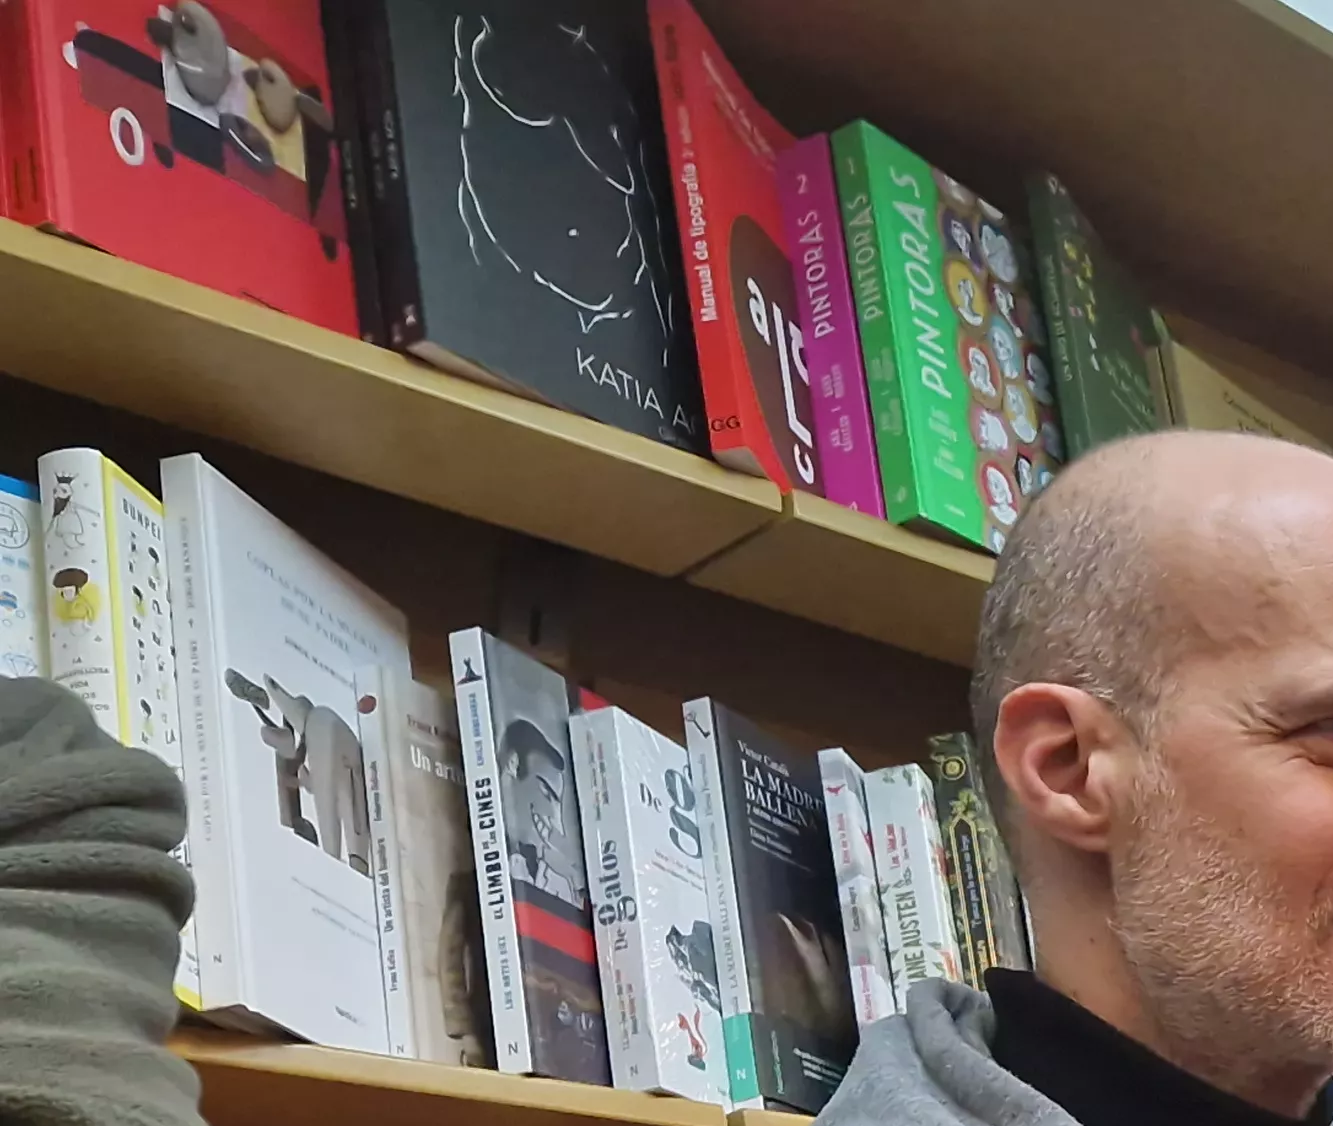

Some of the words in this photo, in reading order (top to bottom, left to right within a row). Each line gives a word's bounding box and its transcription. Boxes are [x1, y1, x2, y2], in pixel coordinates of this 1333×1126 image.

[692, 240, 709, 261] de
[846, 193, 885, 321] PINTORAS
[797, 210, 835, 338] PINTORAS
[890, 165, 953, 399] PINTORAS
[694, 265, 719, 322] Manual
[576, 347, 664, 419] KATIA
[711, 414, 741, 433] GG
[410, 744, 431, 772] Un
[741, 759, 764, 787] LA
[474, 776, 497, 830] CINES
[640, 782, 663, 813] De
[377, 872, 390, 886] del
[483, 850, 506, 906] LIMBO
[593, 839, 638, 926] gatos
[379, 887, 393, 917] artista
[715, 883, 732, 933] BALLENA
[895, 891, 922, 947] AUSTEN
[384, 919, 395, 933] Un
[614, 928, 629, 950] De
[723, 935, 736, 973] MADRE
[507, 1042, 518, 1057] N
